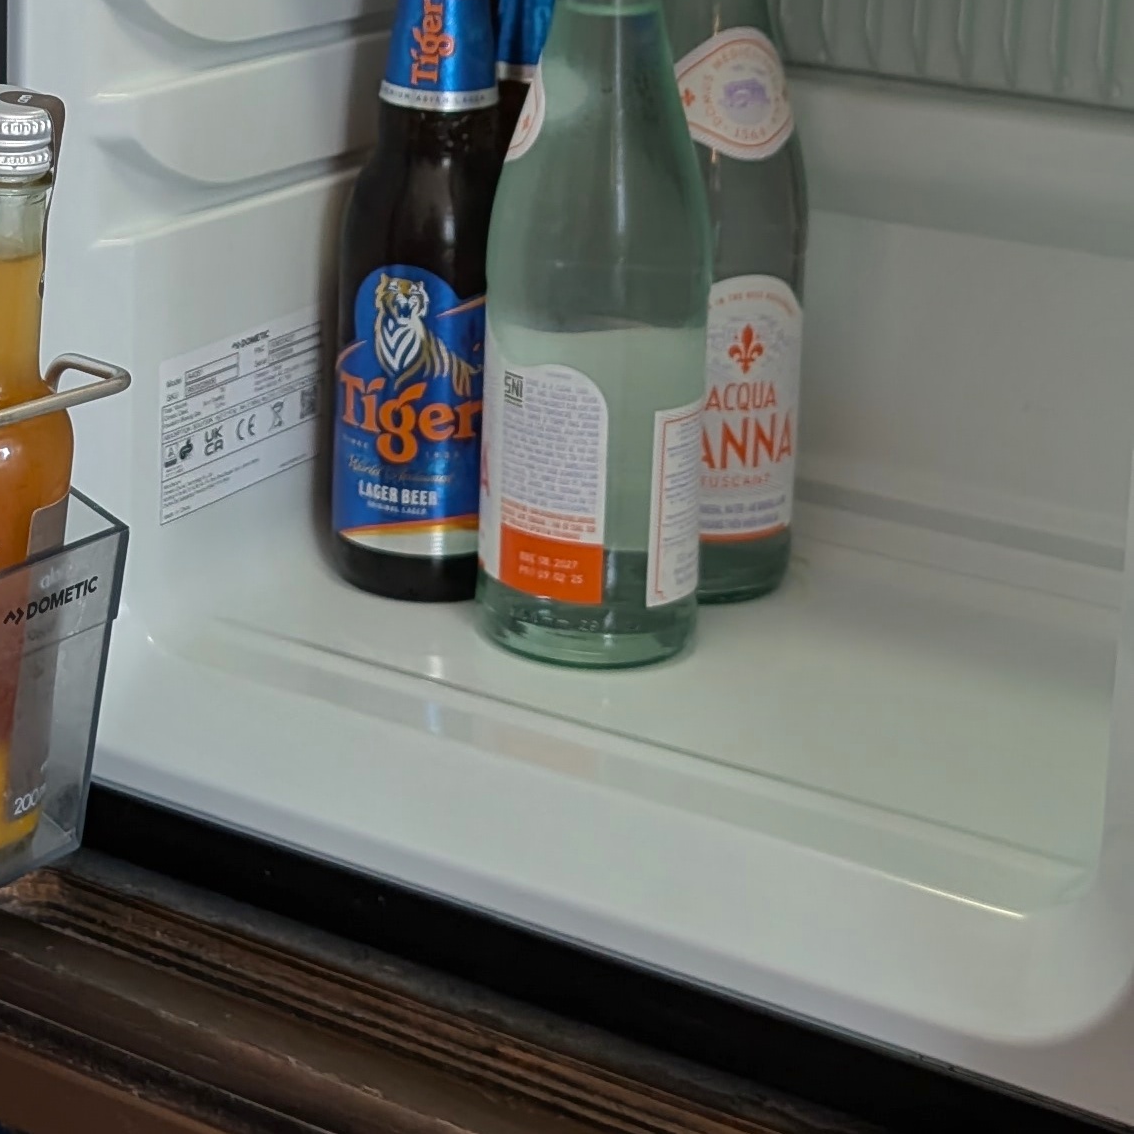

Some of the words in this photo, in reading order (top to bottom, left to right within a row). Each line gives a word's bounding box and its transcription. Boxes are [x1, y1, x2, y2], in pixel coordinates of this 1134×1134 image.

[704, 380, 777, 412] ACQUA
[204, 425, 223, 443] UK
[340, 373, 483, 464] Tiger
[204, 439, 224, 456] CA
[700, 411, 793, 471] ANNA
[357, 479, 398, 503] LAGER
[401, 488, 439, 506] BEER
[26, 575, 98, 620] DOMETIC
